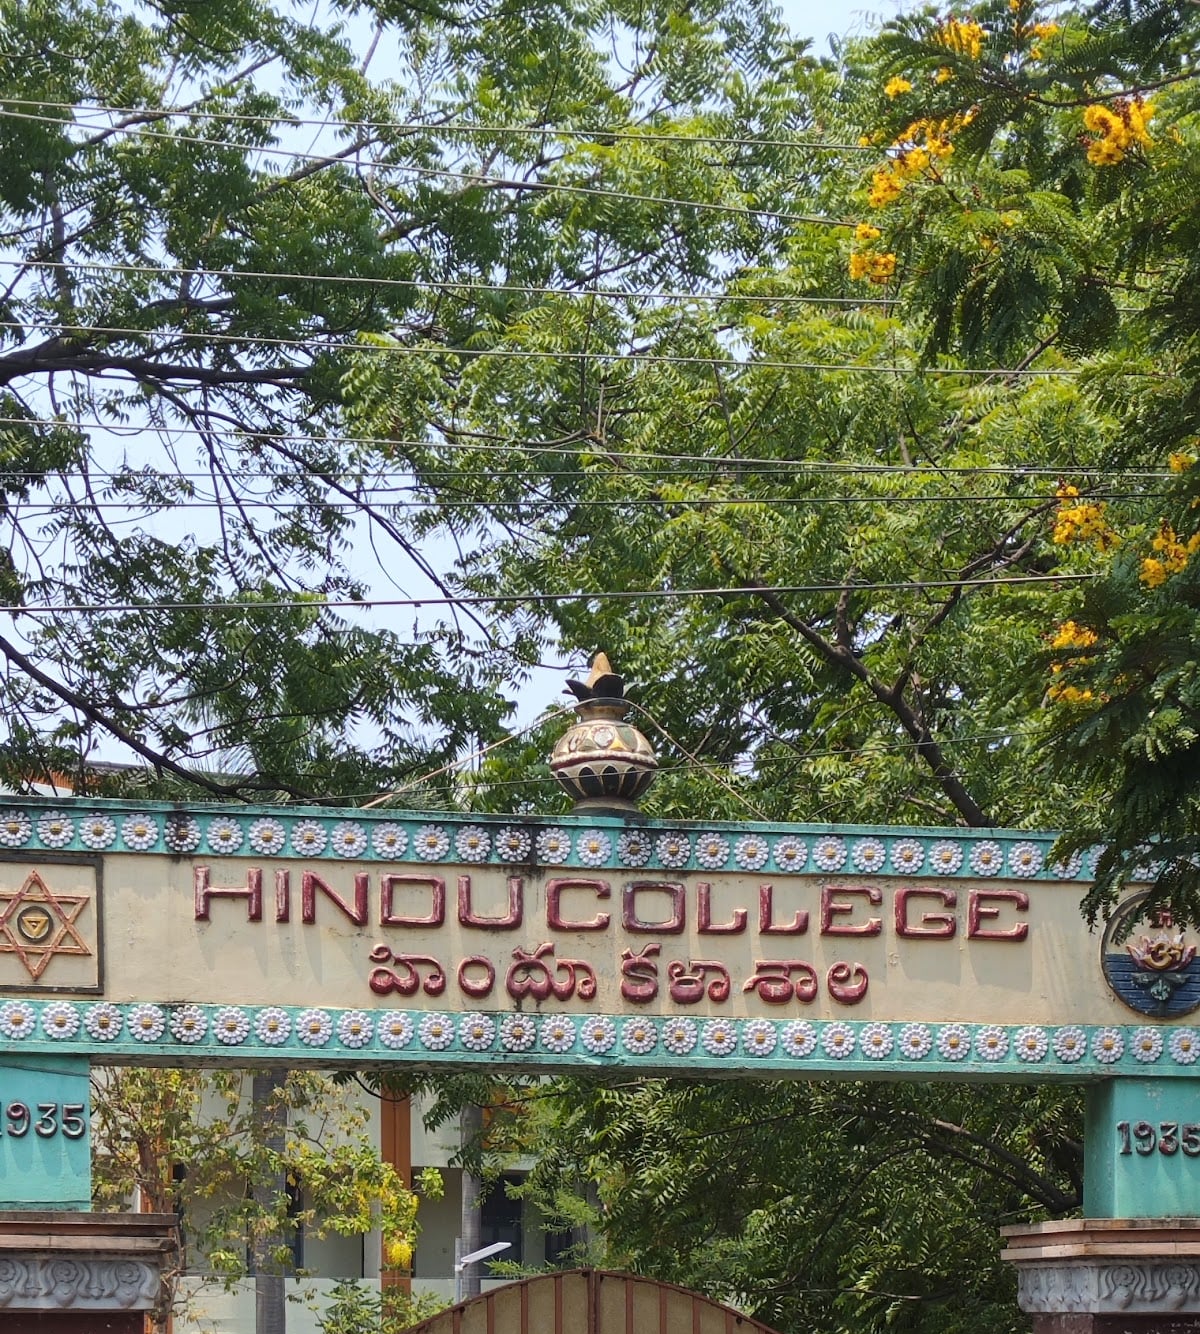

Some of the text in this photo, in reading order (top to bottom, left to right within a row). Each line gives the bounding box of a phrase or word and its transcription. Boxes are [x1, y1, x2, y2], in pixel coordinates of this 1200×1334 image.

[194, 865, 1029, 942] HINDU COLLEGE
[368, 942, 869, 1005] హిందూ కళాశాల
[0, 1101, 86, 1140] 935
[1116, 1120, 1200, 1157] 1935
